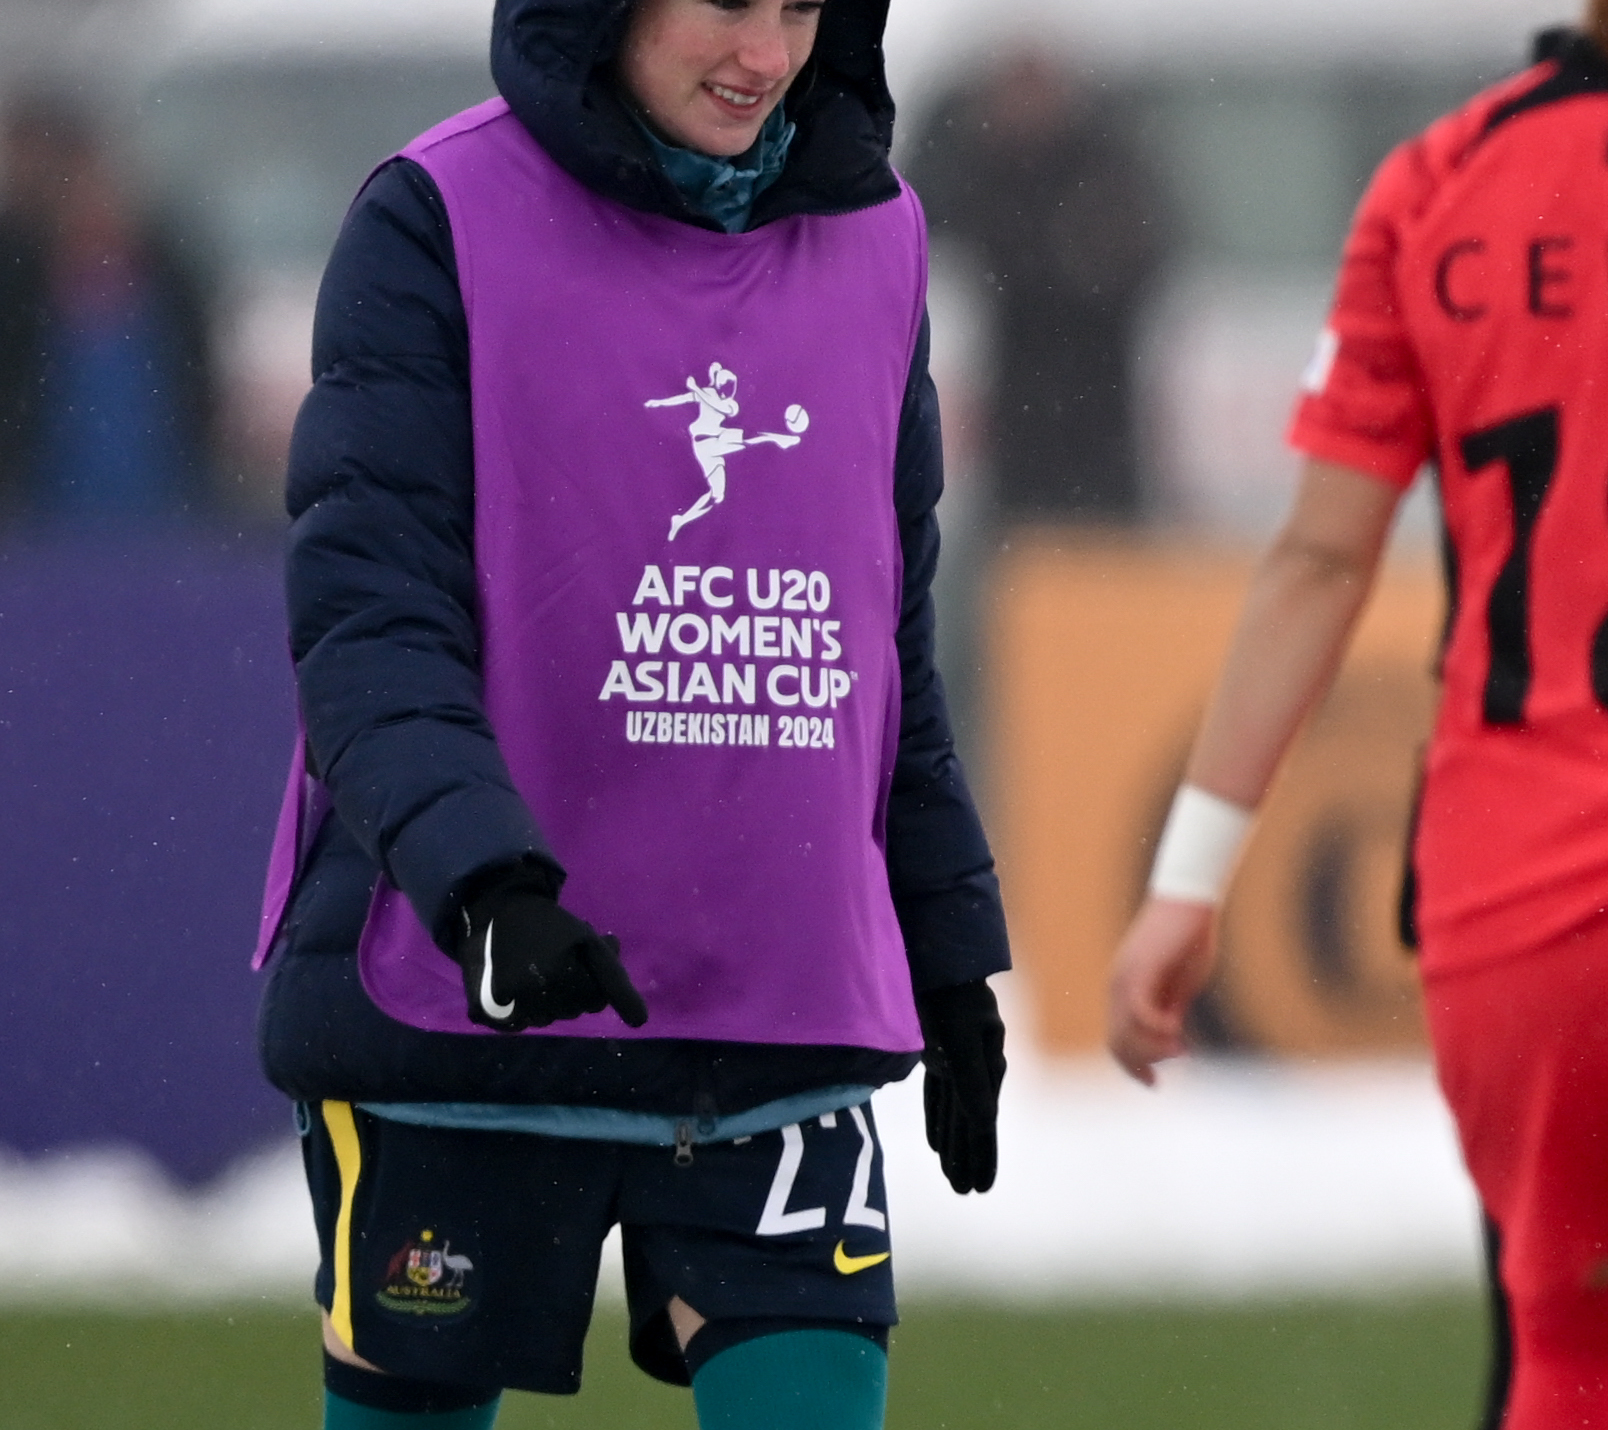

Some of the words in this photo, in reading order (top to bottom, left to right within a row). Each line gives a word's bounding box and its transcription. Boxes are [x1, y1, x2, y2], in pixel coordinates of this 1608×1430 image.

[1434, 238, 1488, 323] C
[1527, 235, 1577, 319] E
[631, 564, 734, 608] AFC
[746, 567, 831, 612] U20
[616, 612, 842, 661] WOMEN'S
[598, 660, 756, 704] ASIAN
[626, 711, 770, 746] UZBEKISTAN
[778, 715, 835, 749] 2024
